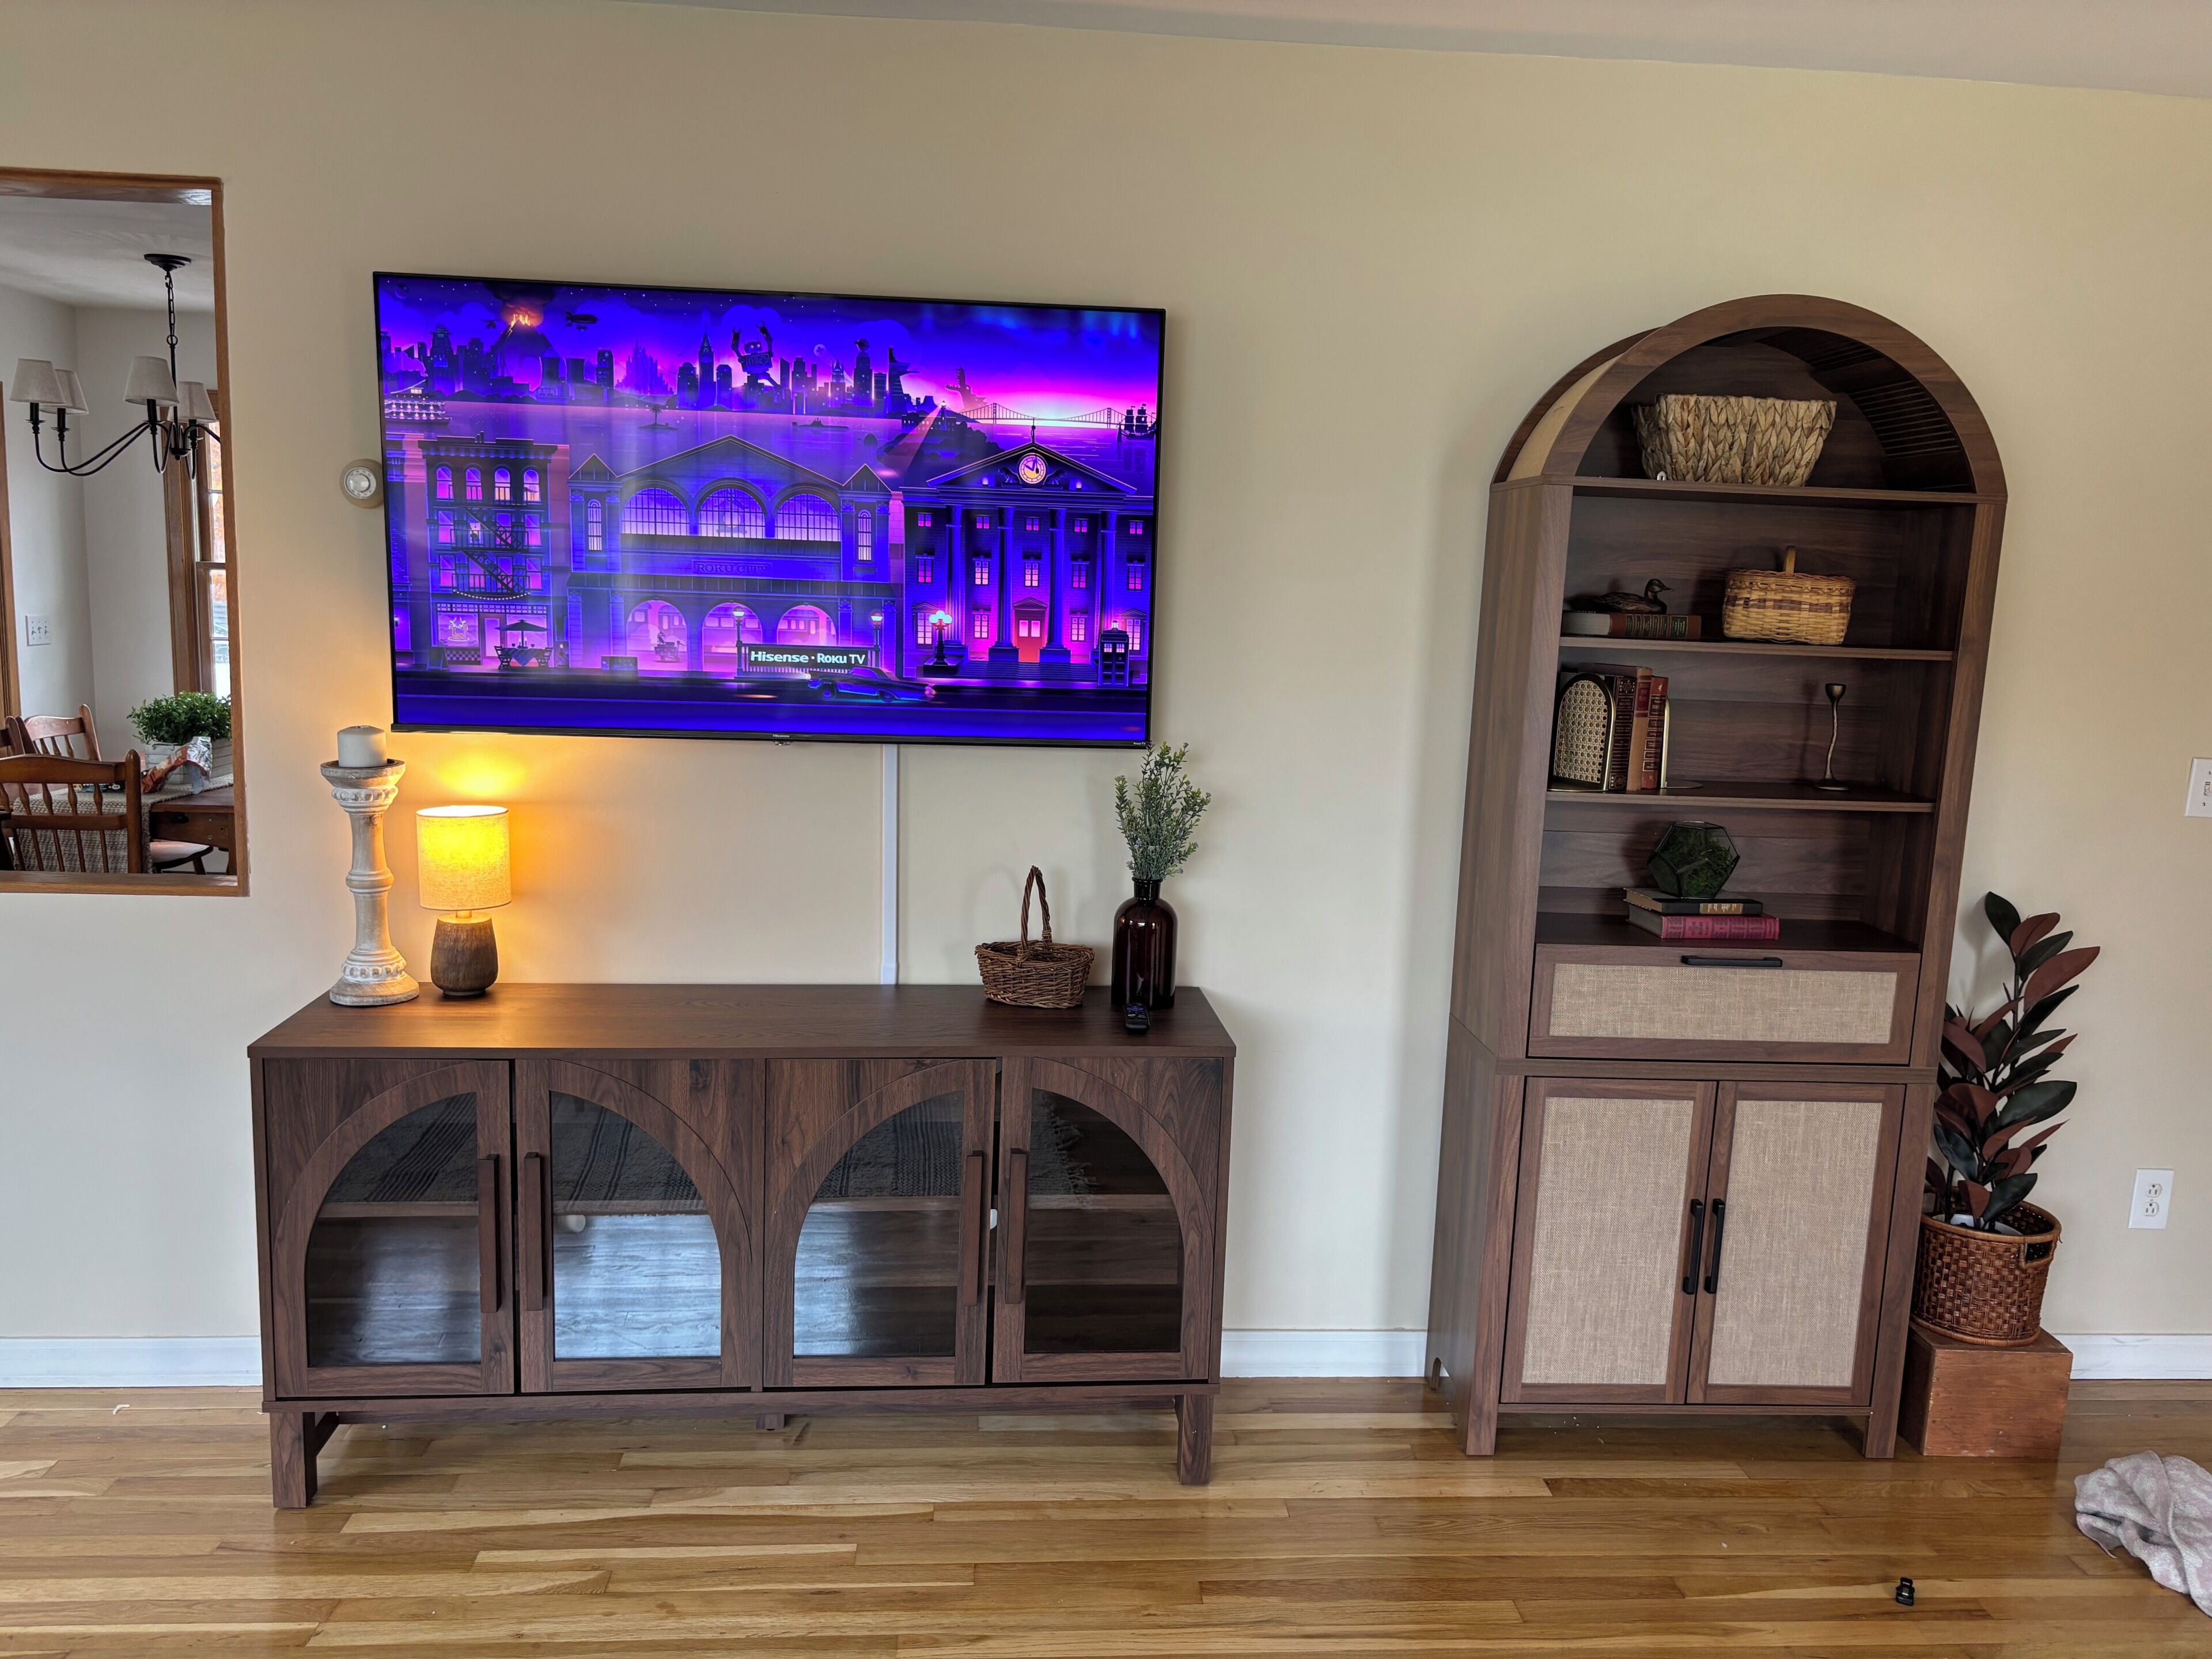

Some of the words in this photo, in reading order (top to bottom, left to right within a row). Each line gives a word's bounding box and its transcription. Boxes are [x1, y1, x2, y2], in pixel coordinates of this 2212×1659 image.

[696, 563, 734, 573] ROKU
[751, 651, 809, 662] Hisense
[817, 653, 847, 664] Roku
[849, 654, 865, 664] TV
